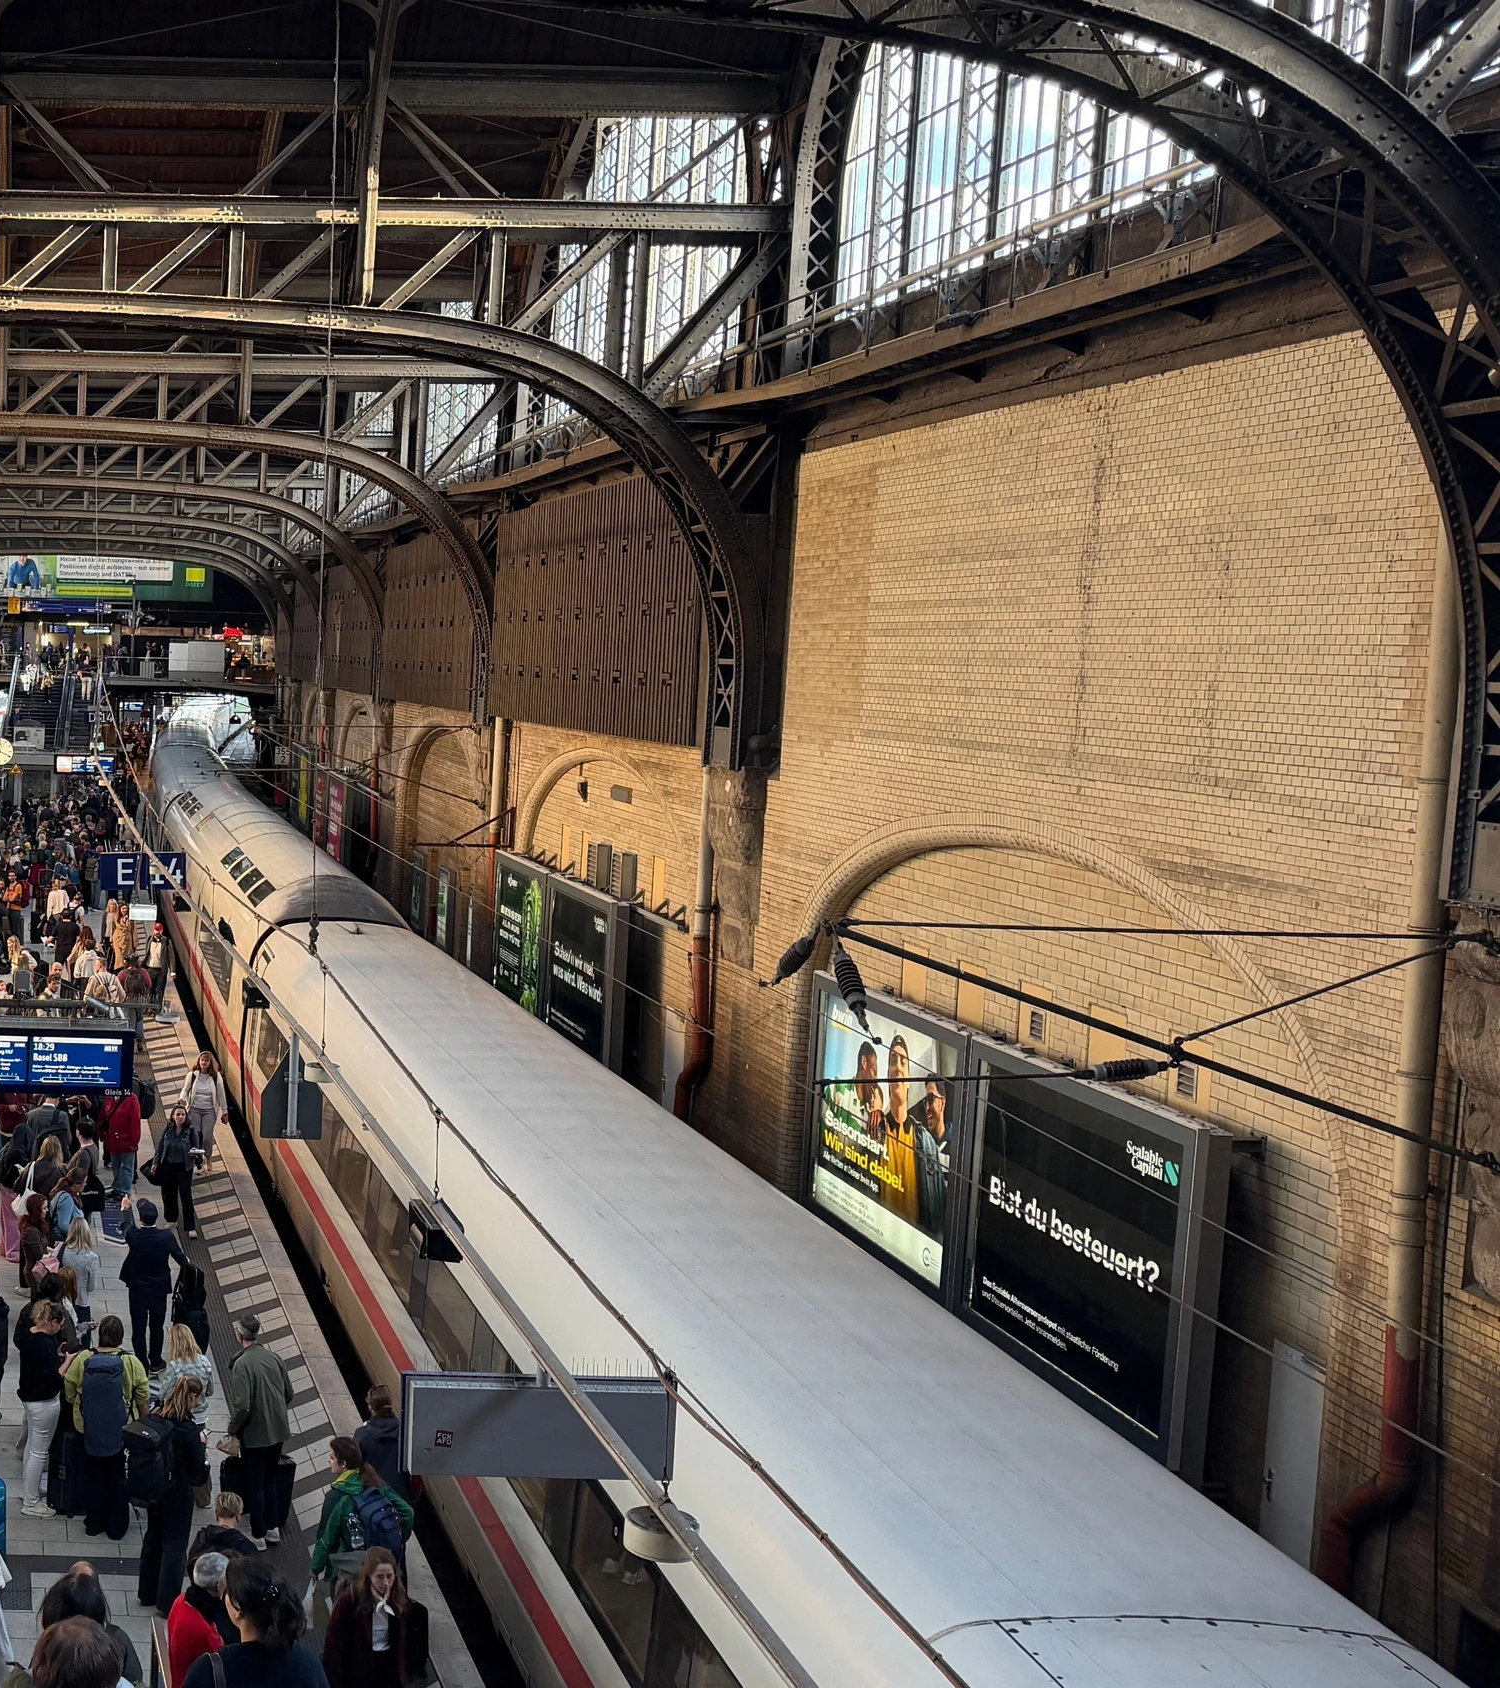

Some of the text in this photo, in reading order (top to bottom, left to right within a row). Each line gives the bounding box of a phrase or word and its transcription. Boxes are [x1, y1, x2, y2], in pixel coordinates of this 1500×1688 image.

[88, 564, 105, 572] digital
[97, 557, 144, 565] Rechnungswesen
[117, 858, 135, 885] E
[500, 904, 522, 924] BESSER
[553, 963, 564, 979] was
[576, 975, 589, 996] Was
[574, 953, 584, 971] wir
[583, 961, 595, 981] mal,
[832, 1004, 852, 1027] bwin
[33, 1042, 55, 1051] 18:29
[33, 1053, 68, 1063] Basel SBB
[104, 1088, 122, 1096] Gleis
[825, 1109, 890, 1161] Saisonstart.
[824, 1129, 905, 1193] Wir sind dabei.
[1126, 1140, 1164, 1168] Scalable
[822, 1150, 833, 1163] Alle
[832, 1153, 844, 1169] Wetten
[860, 1171, 870, 1186] bwin
[870, 1178, 880, 1193] App.
[1131, 1155, 1164, 1182] Capital
[989, 1174, 1161, 1294] Bist du besteuert?
[982, 1289, 1067, 1351] und Steuervorteilen. Jetzt voranmelden.
[982, 1275, 1119, 1372] Das Scalable Altersvorsorgedepot mit staatlicher Förderung
[436, 1438, 452, 1446] AFD
[437, 1432, 453, 1440] FCK
